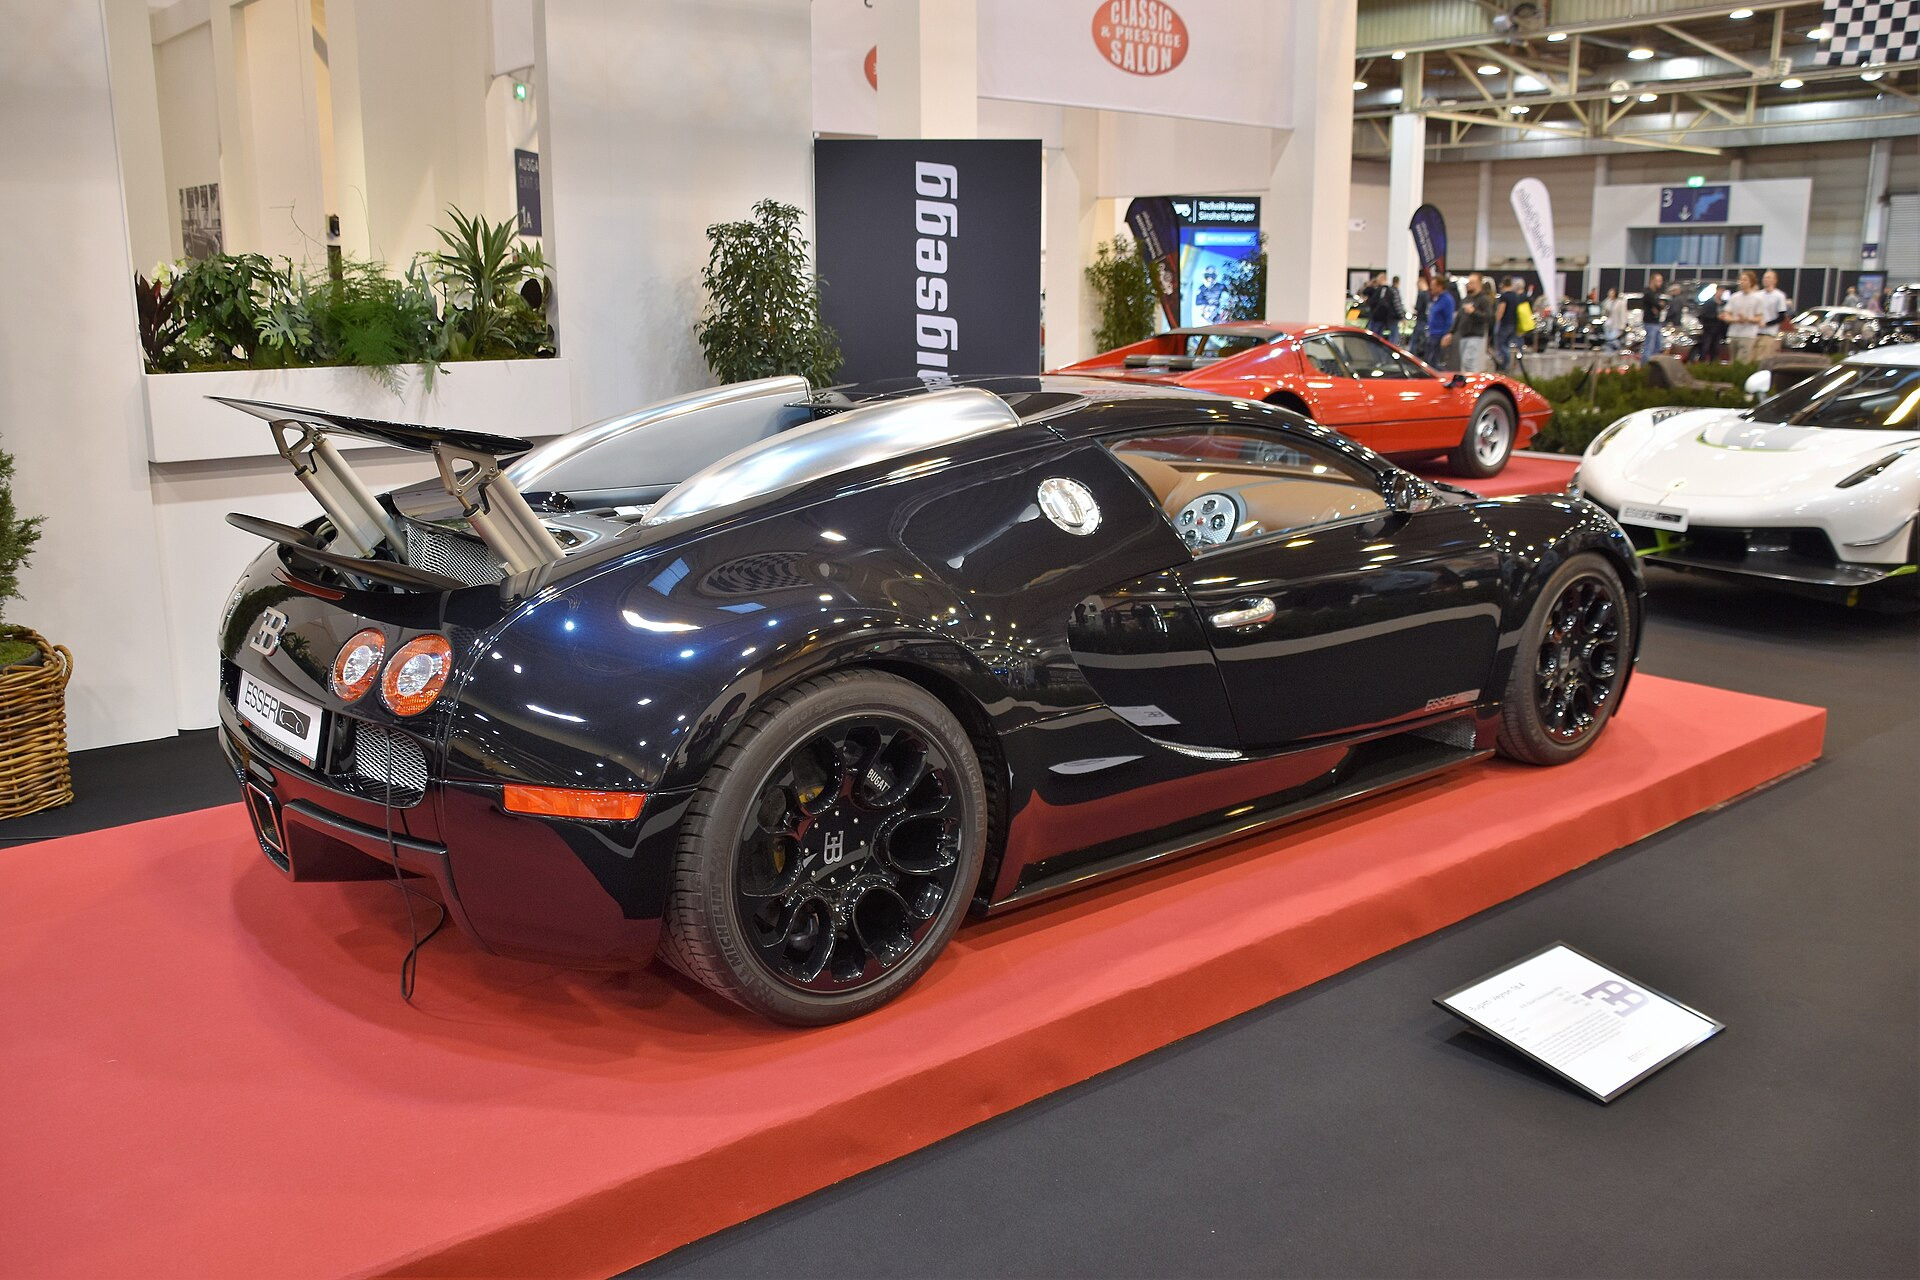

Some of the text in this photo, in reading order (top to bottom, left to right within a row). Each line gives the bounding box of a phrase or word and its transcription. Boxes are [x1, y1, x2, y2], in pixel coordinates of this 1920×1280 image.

[1110, 0, 1172, 32] CLASSIC
[1101, 26, 1181, 48] & PRESTIGE
[1110, 40, 1172, 74] SALON
[1662, 189, 1674, 208] 3
[244, 680, 279, 725] ESSER
